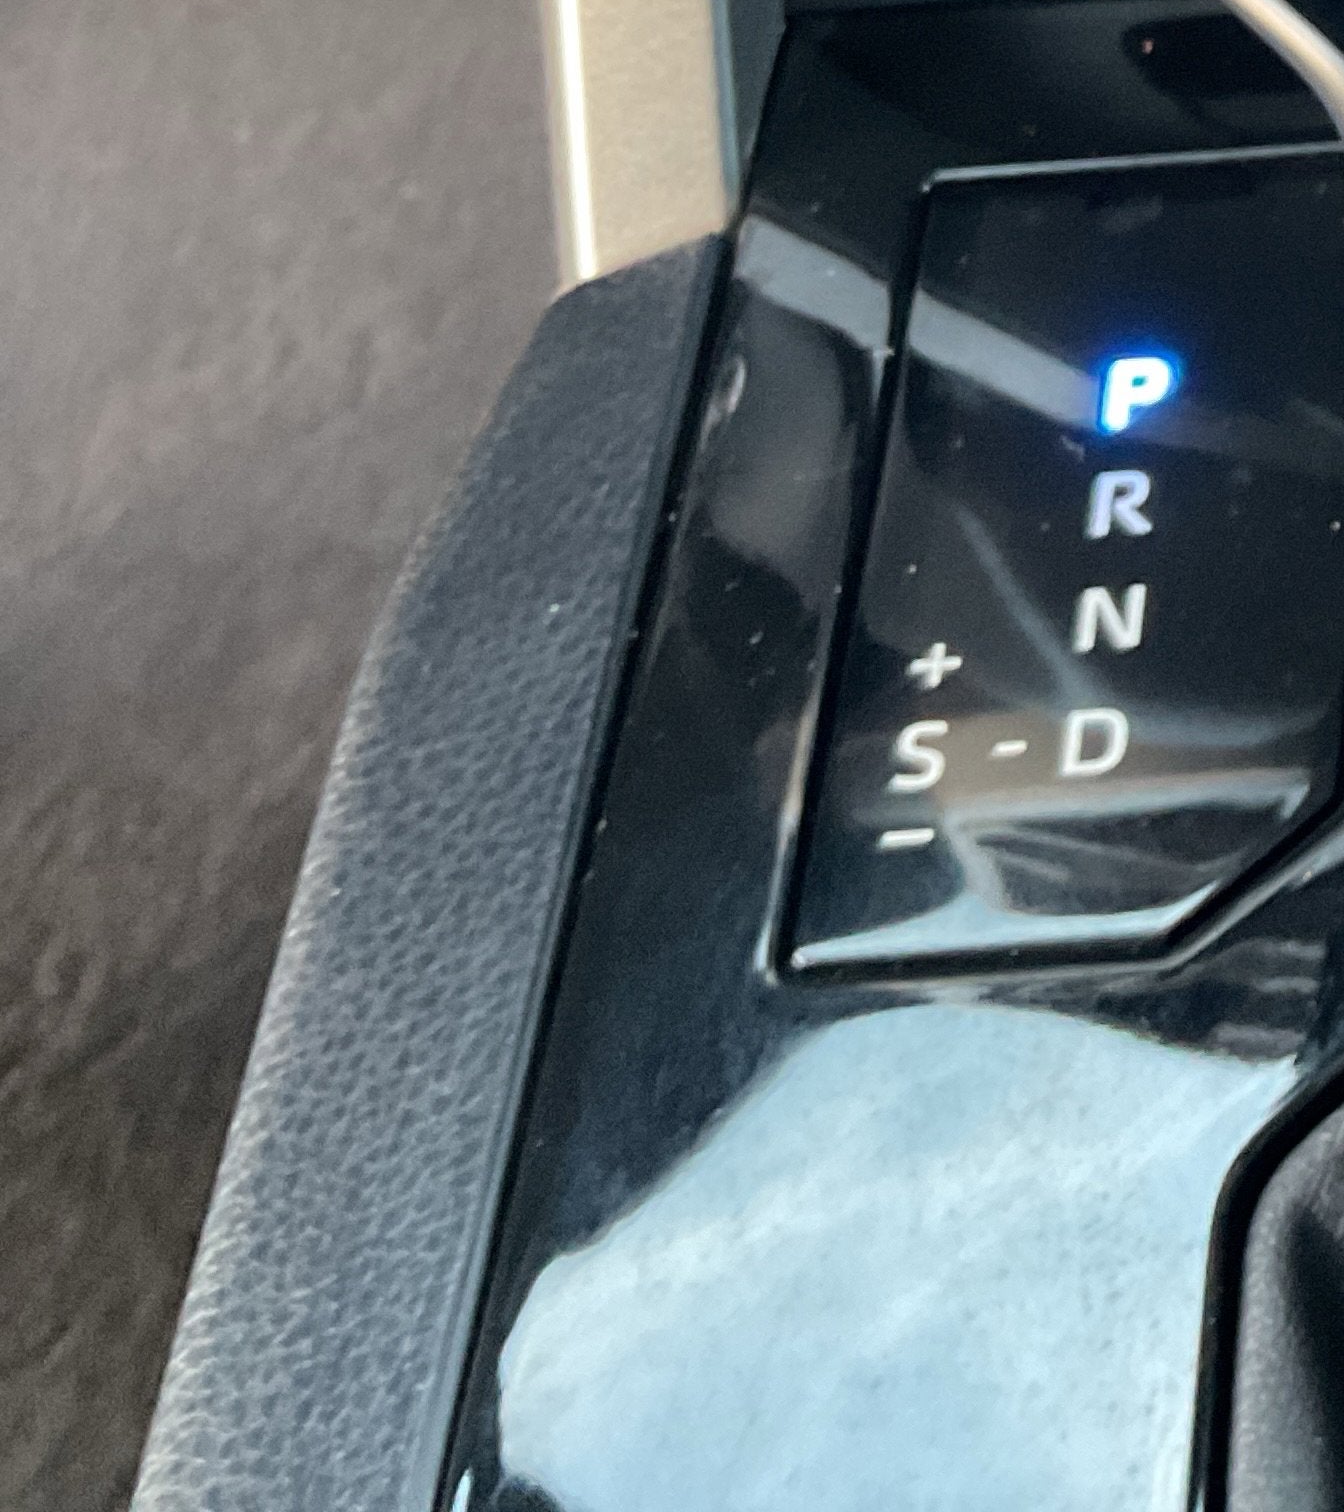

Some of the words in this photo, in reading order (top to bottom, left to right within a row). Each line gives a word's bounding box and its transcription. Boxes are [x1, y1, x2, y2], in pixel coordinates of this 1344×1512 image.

[1101, 356, 1172, 433] P
[1086, 469, 1154, 540] R
[1073, 583, 1148, 654] N
[887, 719, 950, 792] S
[1059, 707, 1130, 778] D
